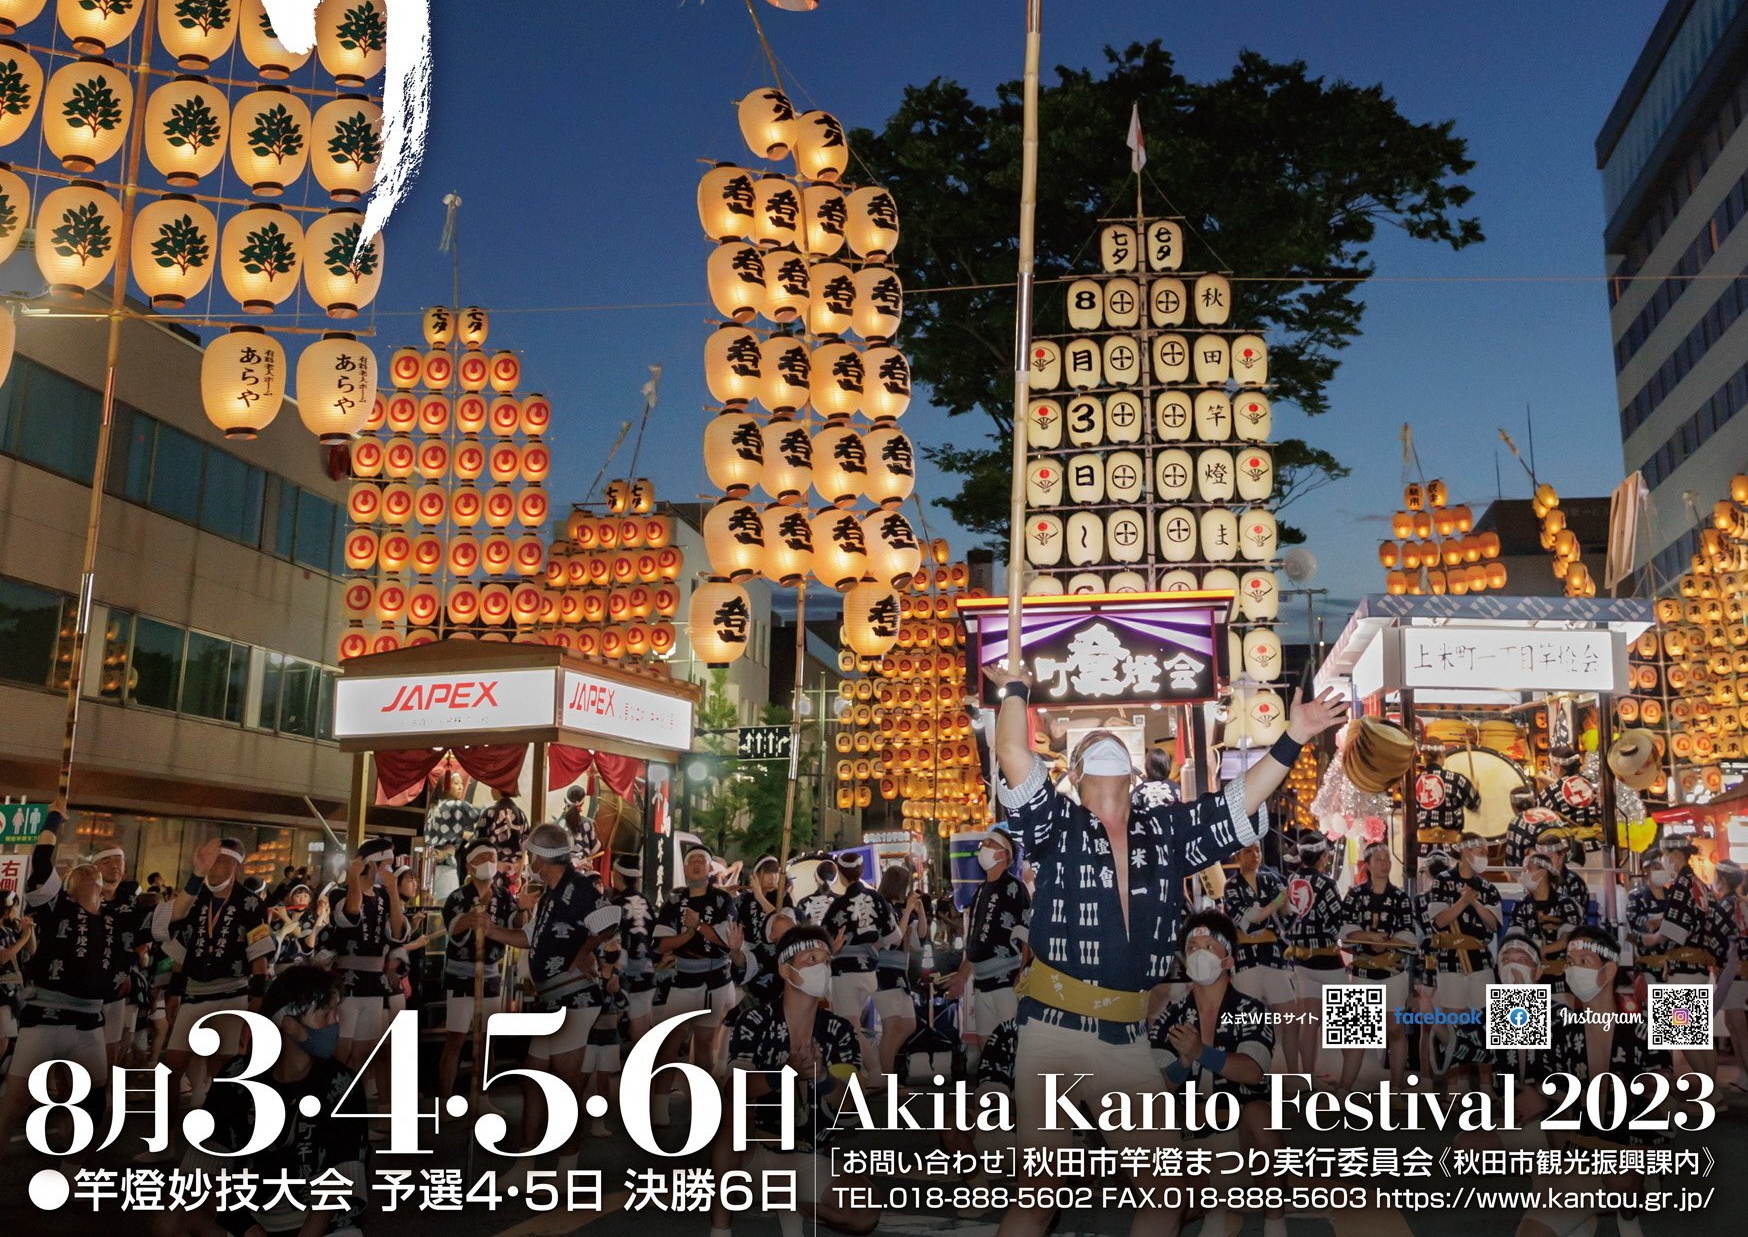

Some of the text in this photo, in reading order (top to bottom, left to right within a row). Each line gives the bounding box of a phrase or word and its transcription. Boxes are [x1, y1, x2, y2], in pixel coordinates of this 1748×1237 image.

[1112, 230, 1128, 265] 七夕
[237, 347, 262, 408] あらや
[333, 354, 356, 414] あらや
[380, 681, 498, 712] JAPEX
[569, 681, 616, 716] JAPEX
